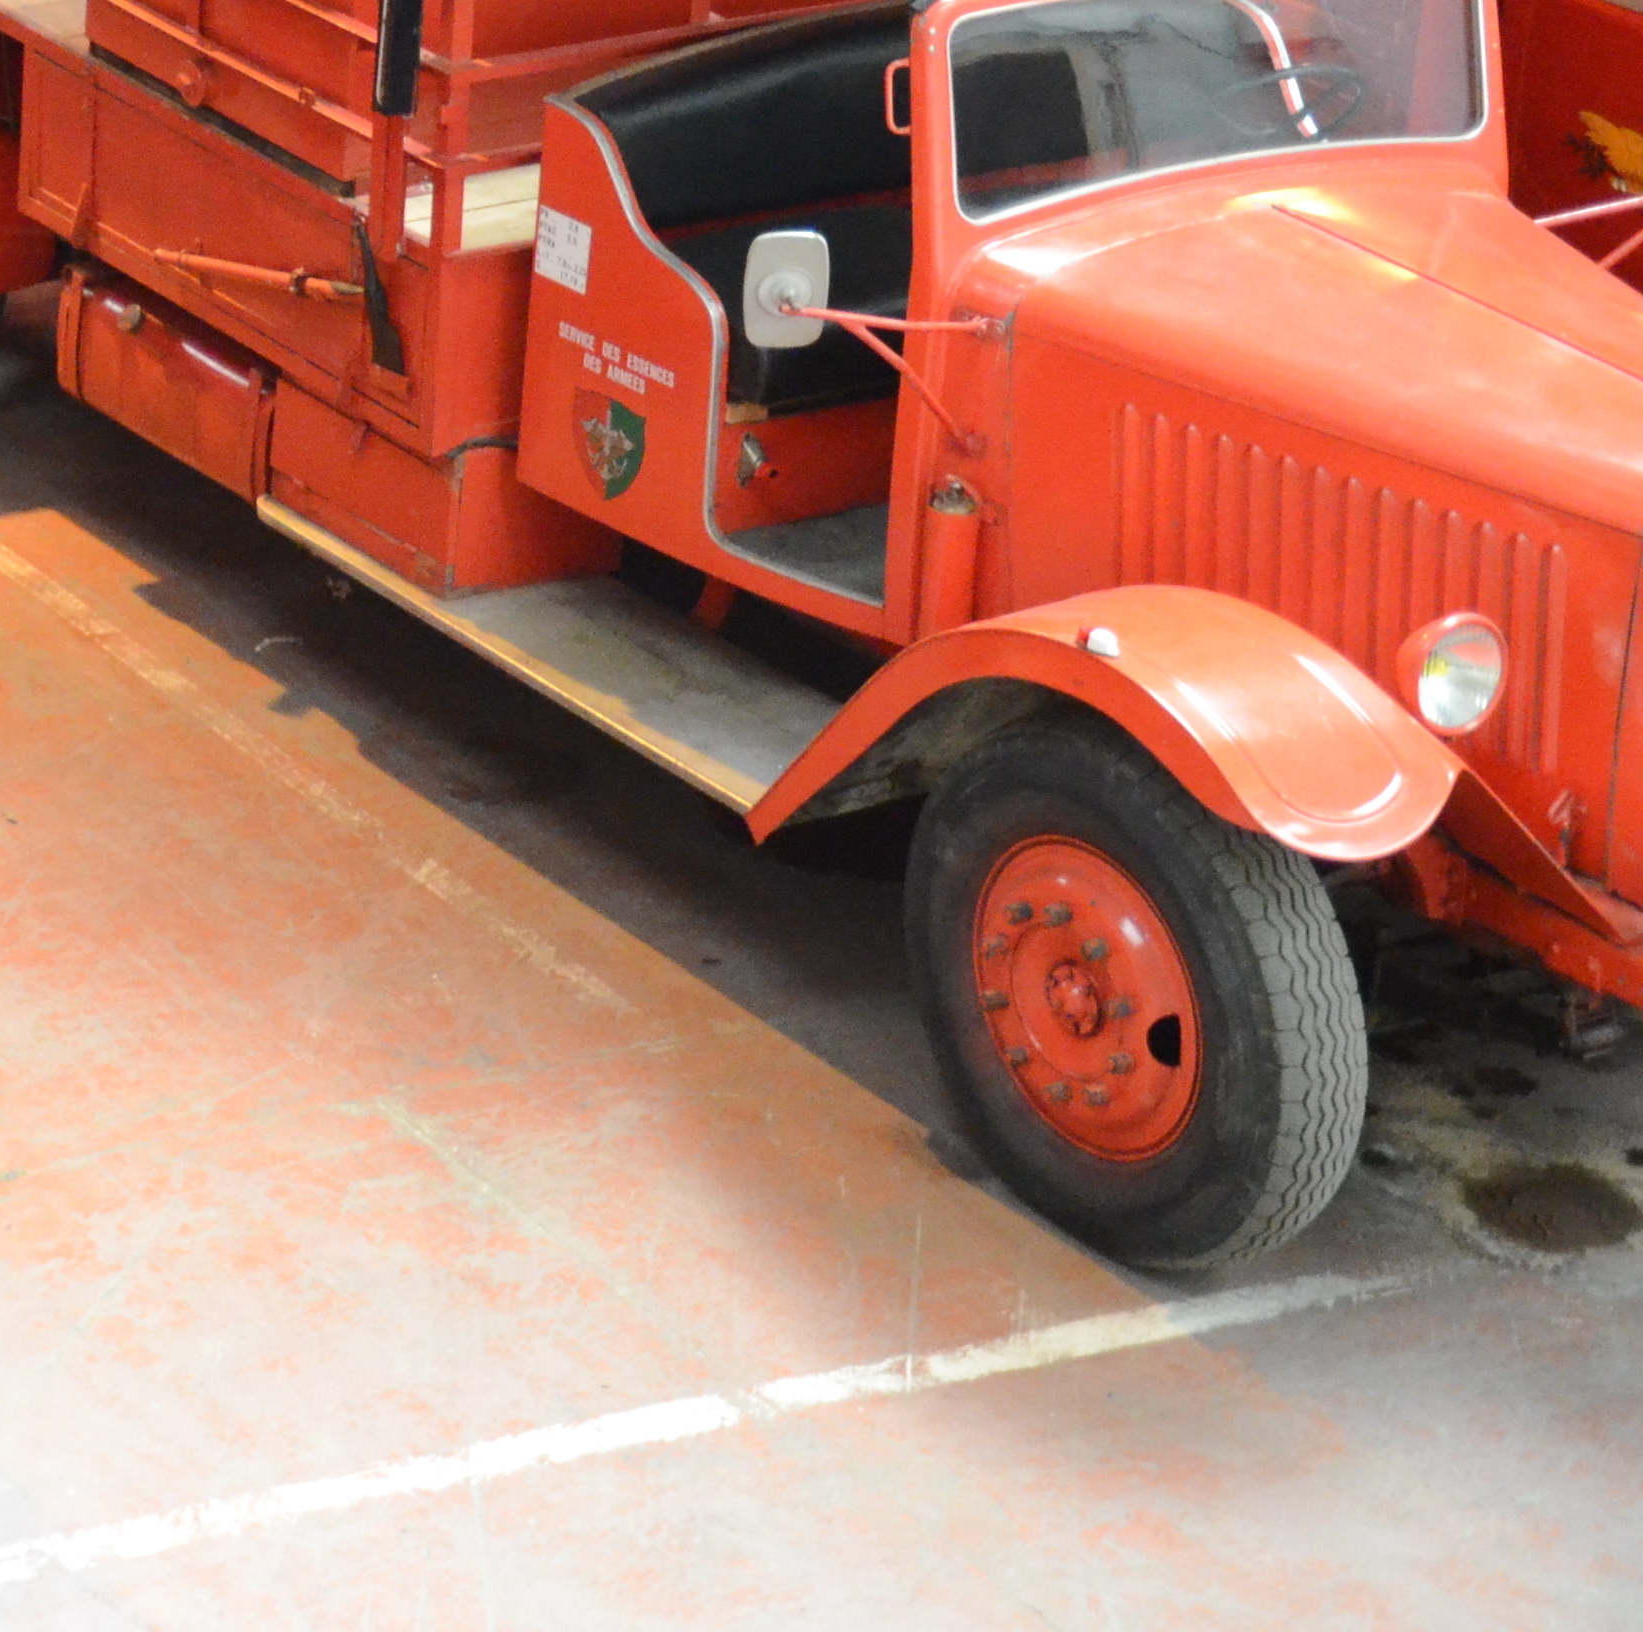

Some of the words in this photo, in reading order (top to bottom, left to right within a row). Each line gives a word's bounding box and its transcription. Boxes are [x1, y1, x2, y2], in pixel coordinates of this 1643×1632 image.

[558, 320, 595, 352] SERVICE
[602, 340, 621, 364] DES
[626, 352, 675, 388] ESSENCES
[582, 352, 602, 375] DES
